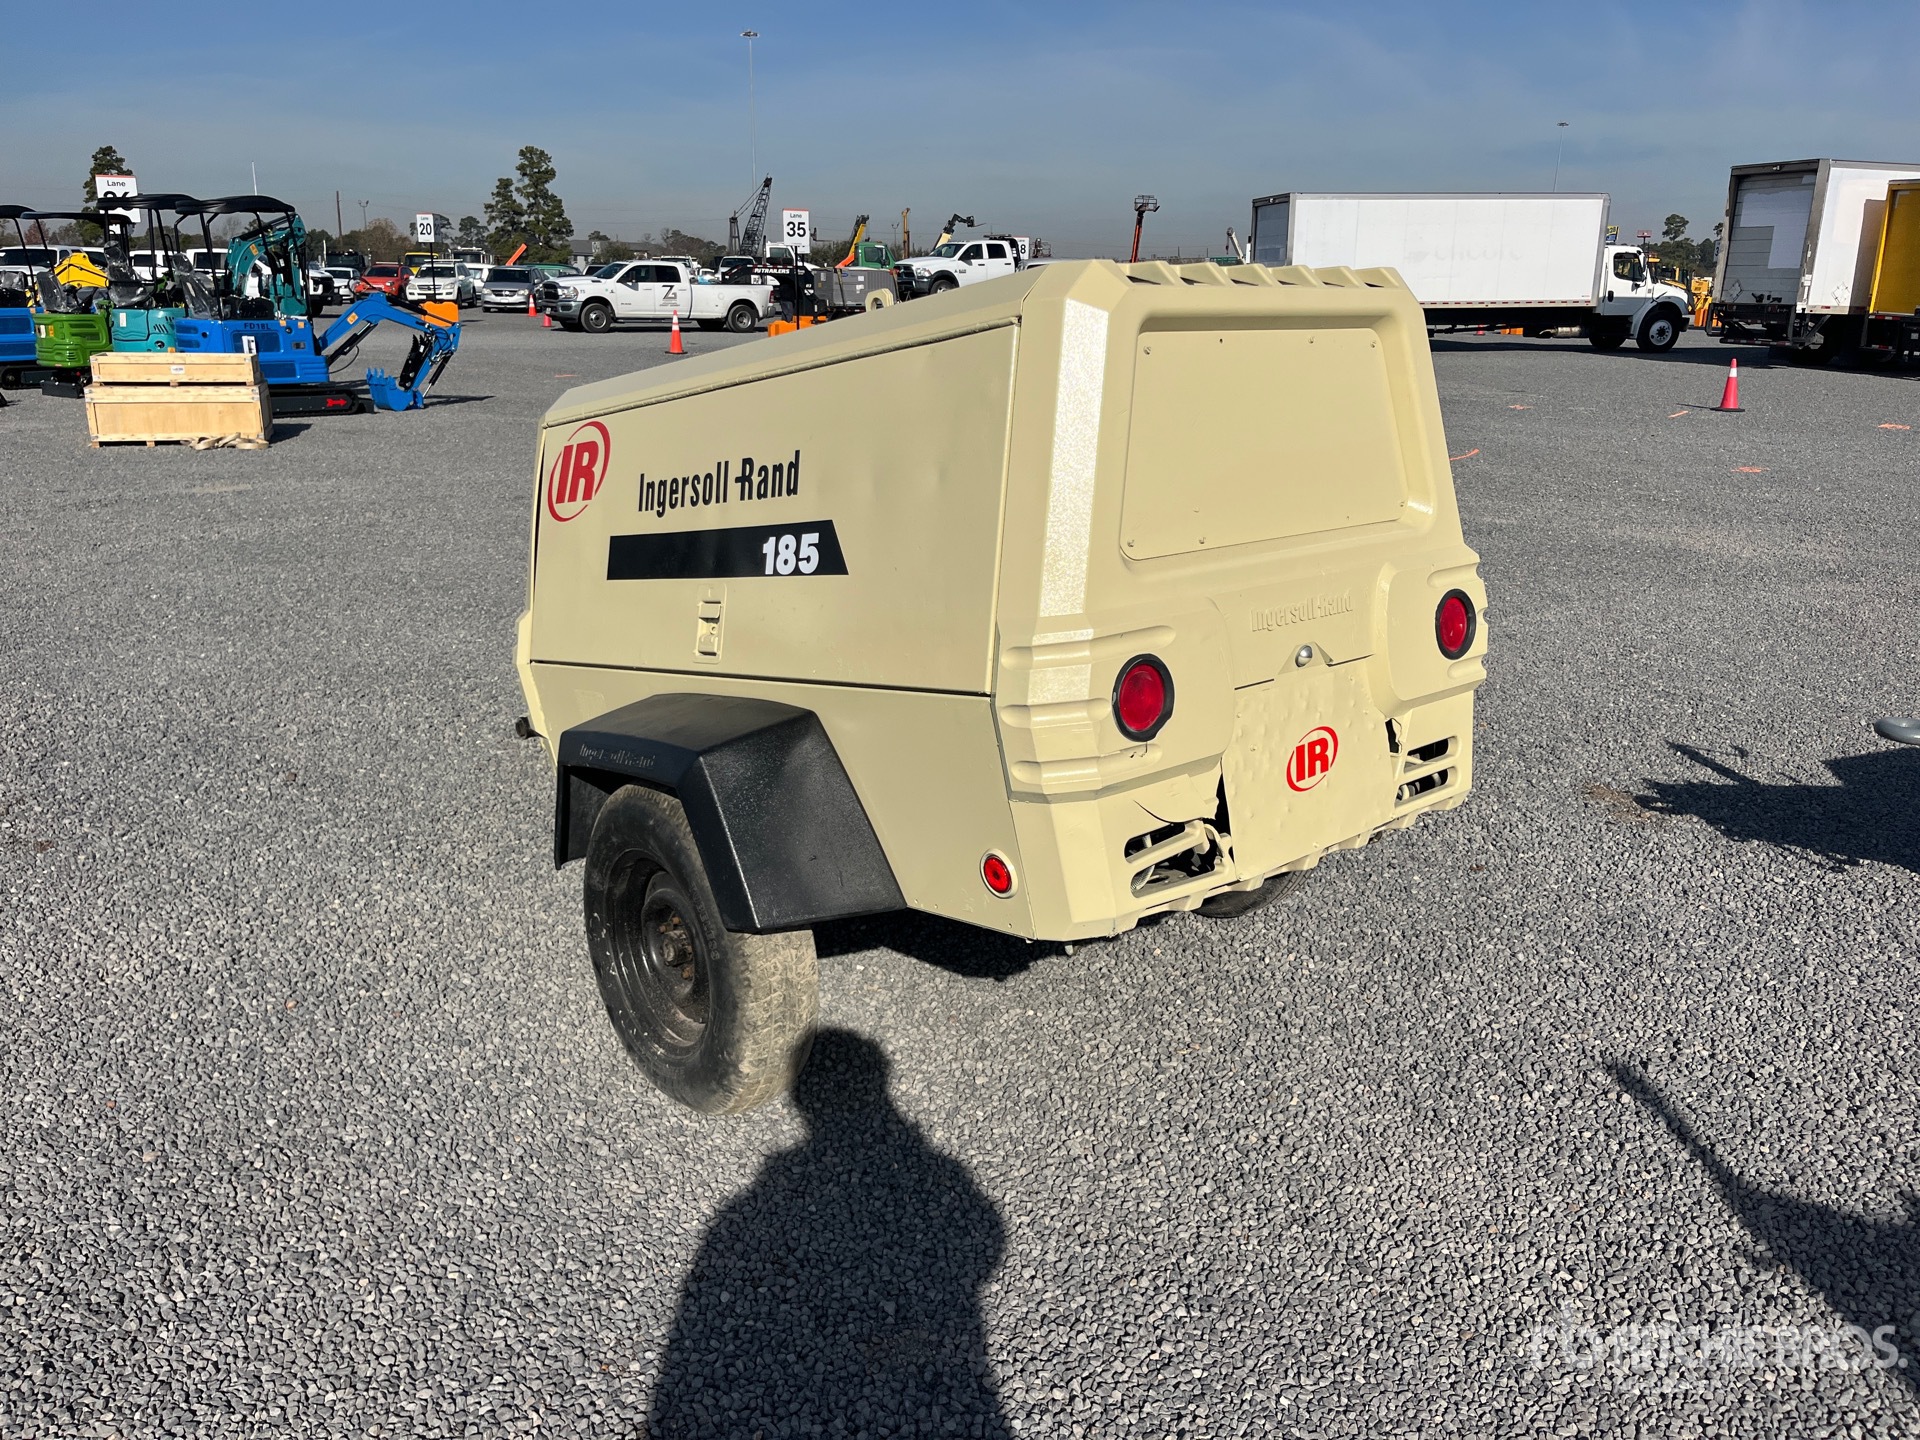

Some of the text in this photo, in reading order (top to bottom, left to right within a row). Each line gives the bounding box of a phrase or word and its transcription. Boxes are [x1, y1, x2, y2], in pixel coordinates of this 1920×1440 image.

[419, 222, 432, 236] 20
[786, 221, 807, 238] 35
[556, 440, 599, 504] IR
[762, 532, 820, 575] 185
[1295, 737, 1331, 783] IR
